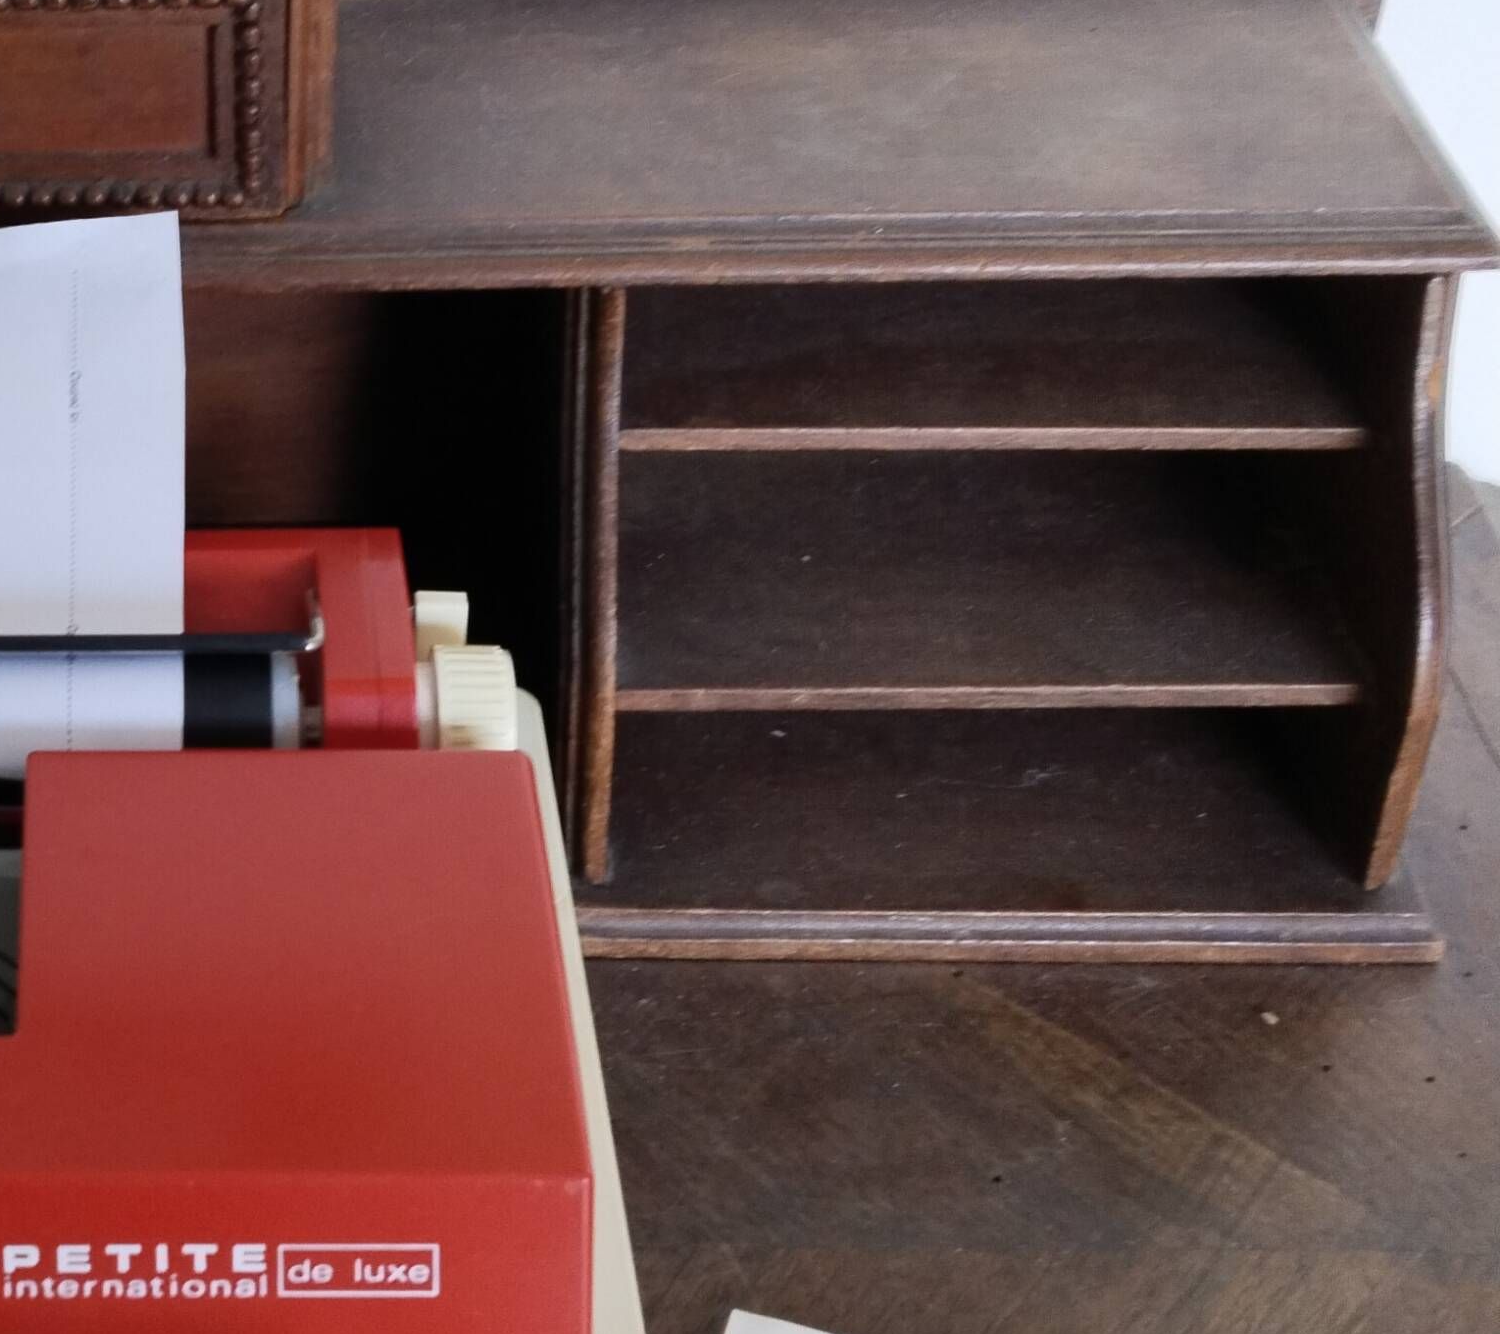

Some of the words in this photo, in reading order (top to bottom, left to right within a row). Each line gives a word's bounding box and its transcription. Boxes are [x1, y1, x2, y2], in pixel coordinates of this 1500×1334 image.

[2, 1243, 268, 1273] PETITE
[287, 1258, 333, 1284] de
[353, 1257, 431, 1284] luxe
[3, 1272, 268, 1300] international
